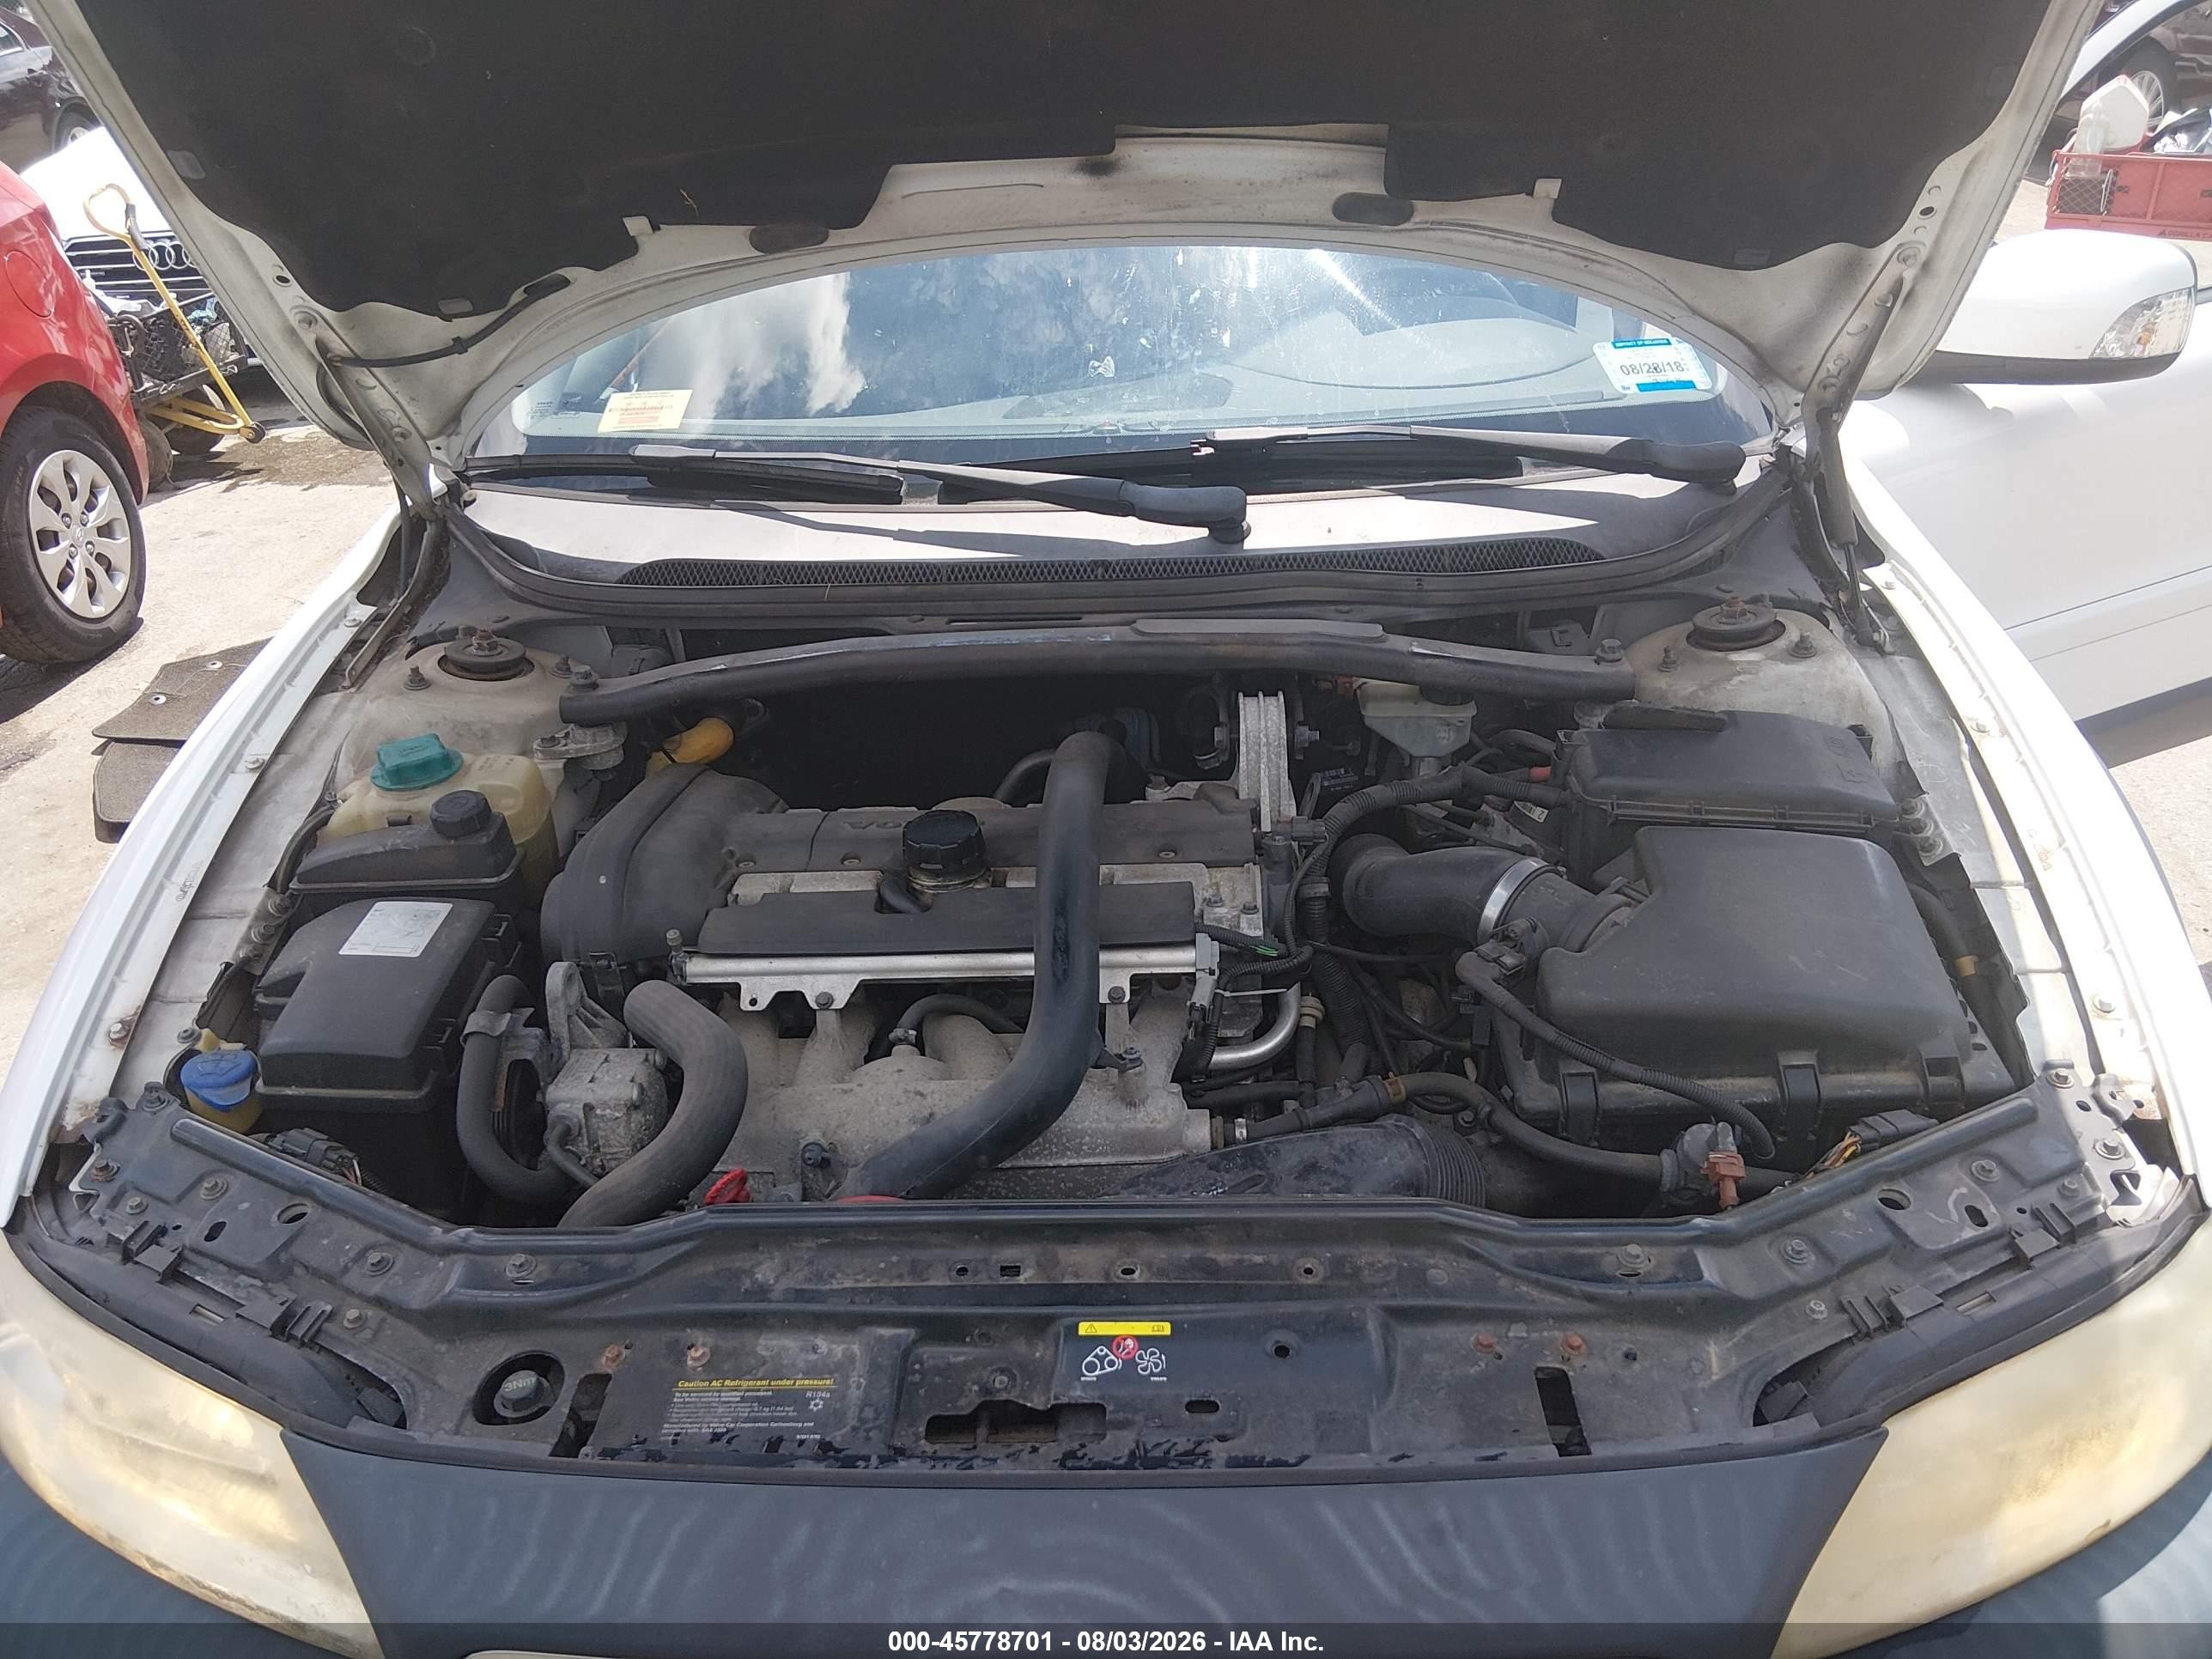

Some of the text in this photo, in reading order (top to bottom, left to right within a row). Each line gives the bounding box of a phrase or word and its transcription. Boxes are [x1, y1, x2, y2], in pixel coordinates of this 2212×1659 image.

[504, 1377, 536, 1392] 3Nm
[724, 1379, 769, 1388] Refrigerant
[795, 1378, 834, 1387] pressure!
